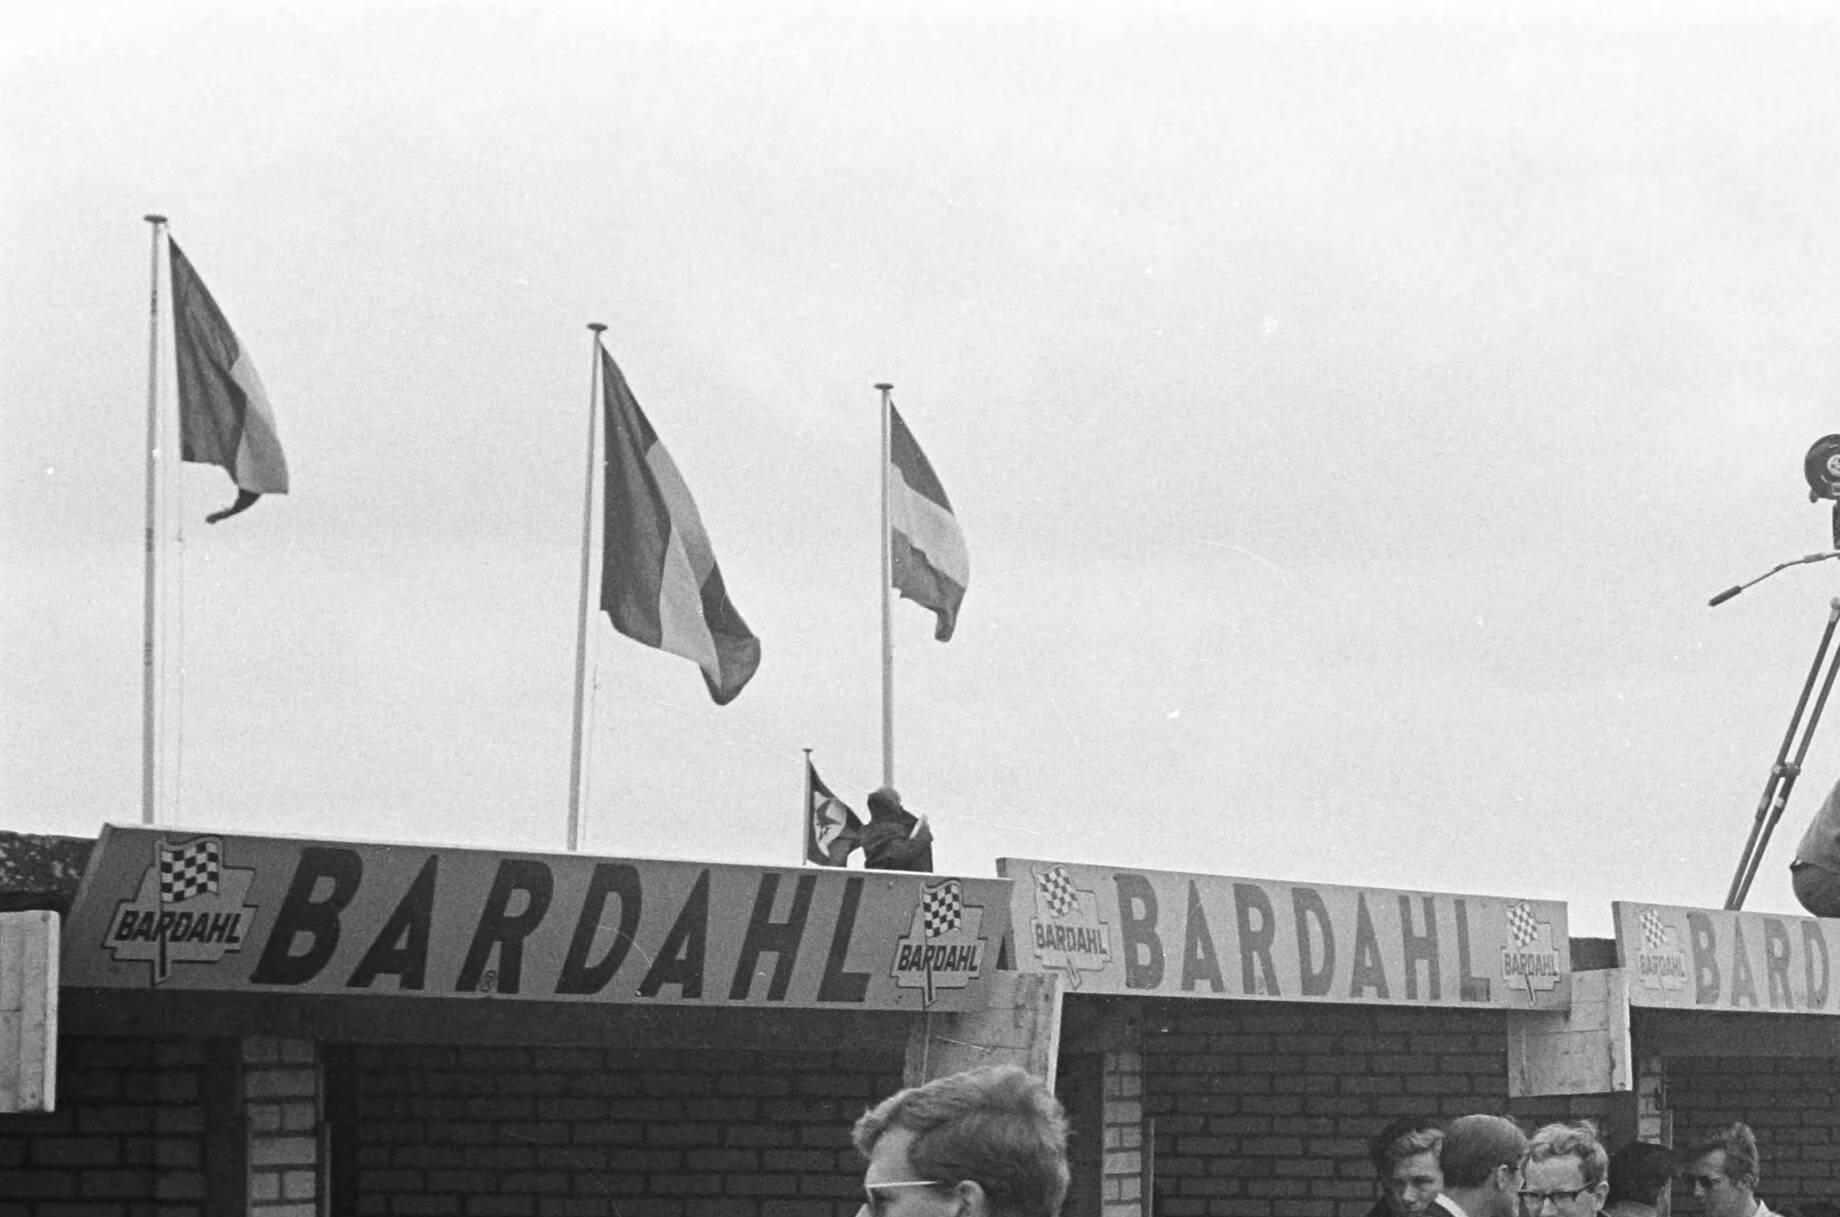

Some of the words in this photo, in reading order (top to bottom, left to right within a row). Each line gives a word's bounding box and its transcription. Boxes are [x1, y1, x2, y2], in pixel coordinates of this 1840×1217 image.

[114, 908, 242, 945] BARDAHL
[249, 846, 872, 1002] BARDAHL
[1034, 922, 1108, 956] BARDAHL
[1114, 873, 1492, 1002] BARDAHL
[898, 943, 979, 973] BARDAHL
[1503, 951, 1559, 979] BARDAHL
